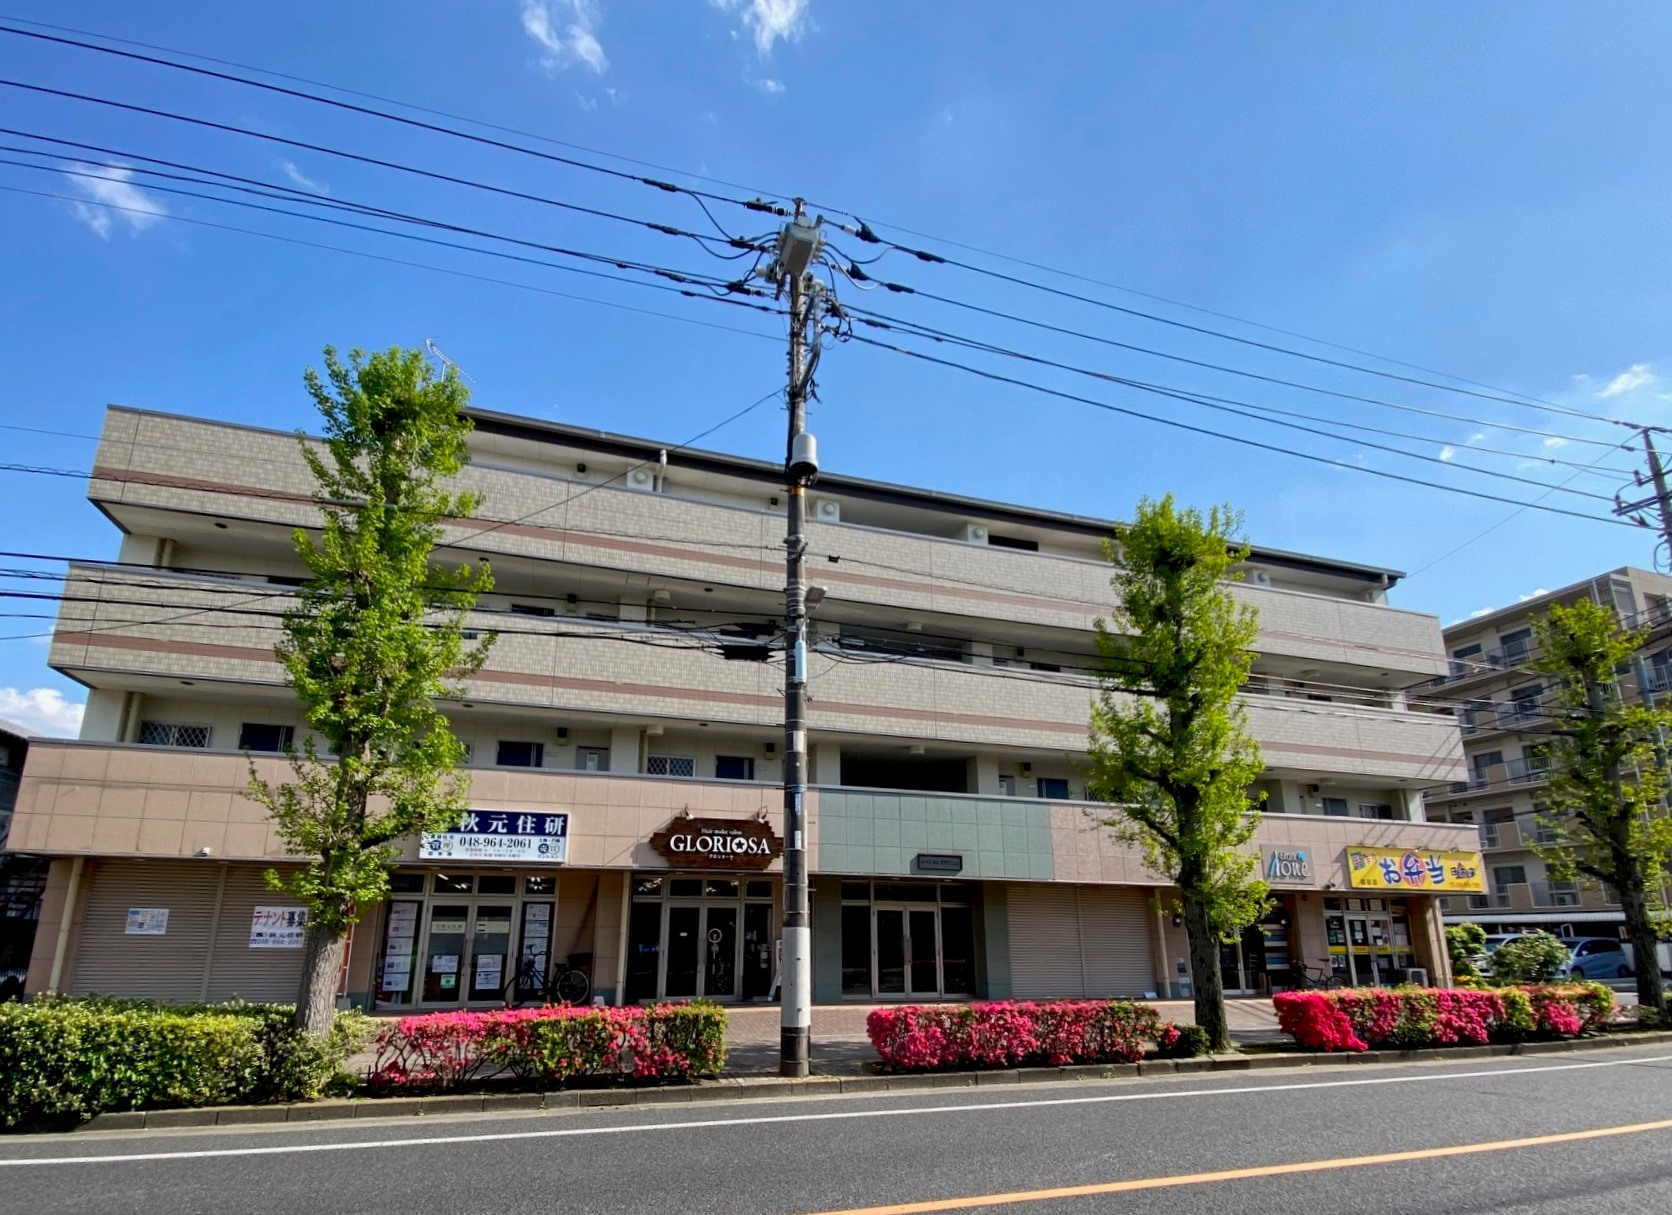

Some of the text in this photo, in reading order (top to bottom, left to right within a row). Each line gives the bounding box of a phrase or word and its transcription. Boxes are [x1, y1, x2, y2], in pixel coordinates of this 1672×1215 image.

[459, 836, 533, 849] 048-964-2061
[669, 834, 771, 854] GLORIOSA
[1379, 851, 1446, 885] お弁当
[253, 909, 307, 928] テナント募集
